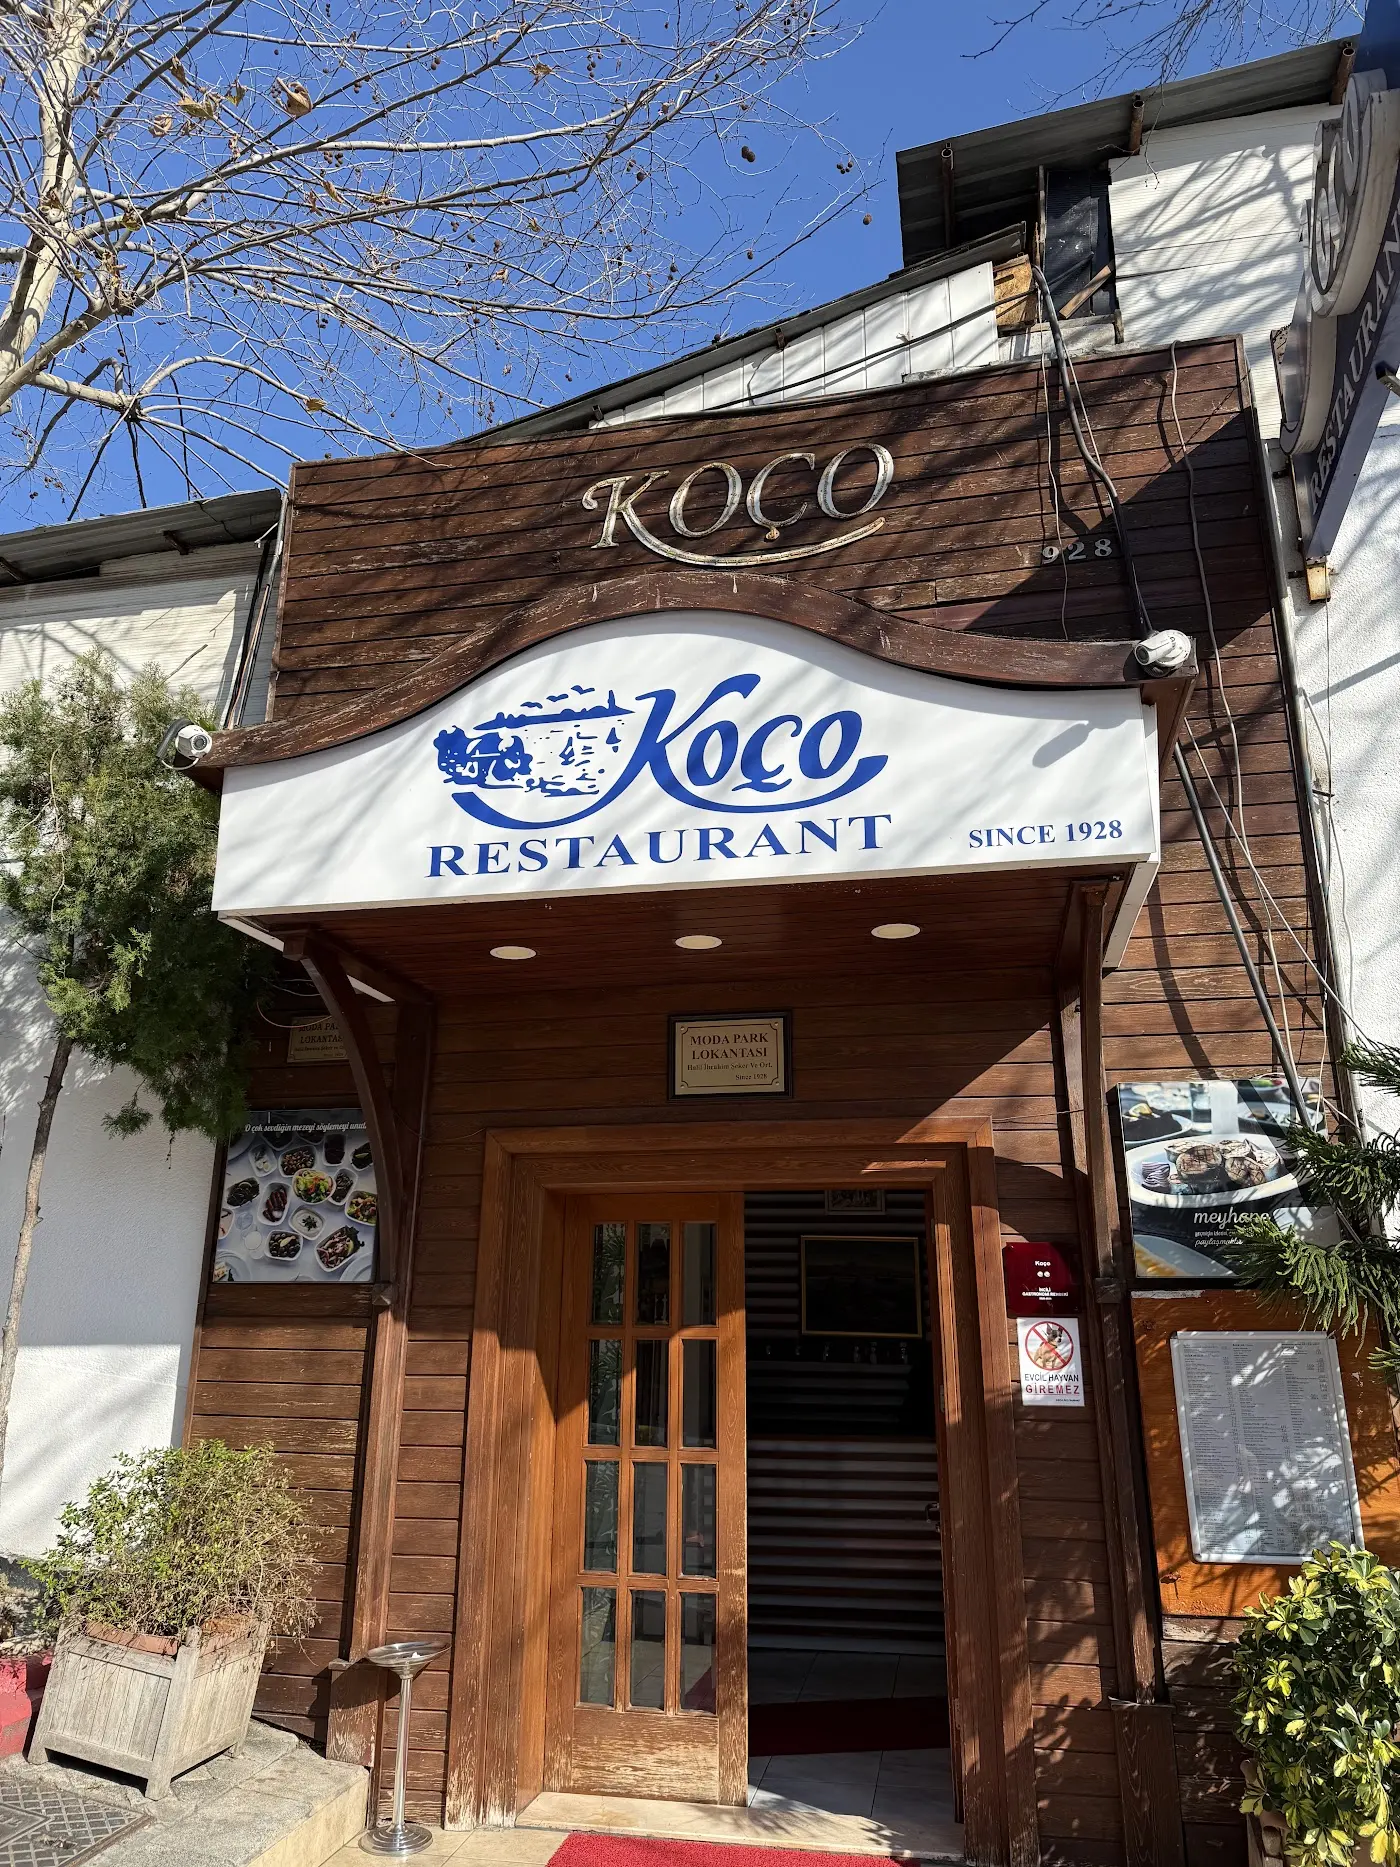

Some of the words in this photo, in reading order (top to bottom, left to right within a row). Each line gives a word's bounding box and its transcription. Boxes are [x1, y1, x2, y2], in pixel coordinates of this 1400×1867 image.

[1312, 198, 1400, 515] RESTAURAN
[582, 443, 894, 567] KOÇO
[969, 824, 1055, 849] SINCE
[1065, 819, 1123, 842] 1928
[425, 814, 892, 878] RESTAURANT
[690, 1035, 730, 1045] MODA
[733, 1033, 769, 1043] PARK
[692, 1047, 767, 1060] LOKANTASI
[735, 1073, 752, 1081] Since
[263, 1124, 292, 1134] sevdiğin
[292, 1123, 315, 1133] mezeyi
[317, 1122, 349, 1133] söylemeyi
[1024, 1372, 1047, 1382] EVCİL
[1048, 1374, 1079, 1382] HAYVAN
[1025, 1383, 1080, 1395] GİREMEZ
